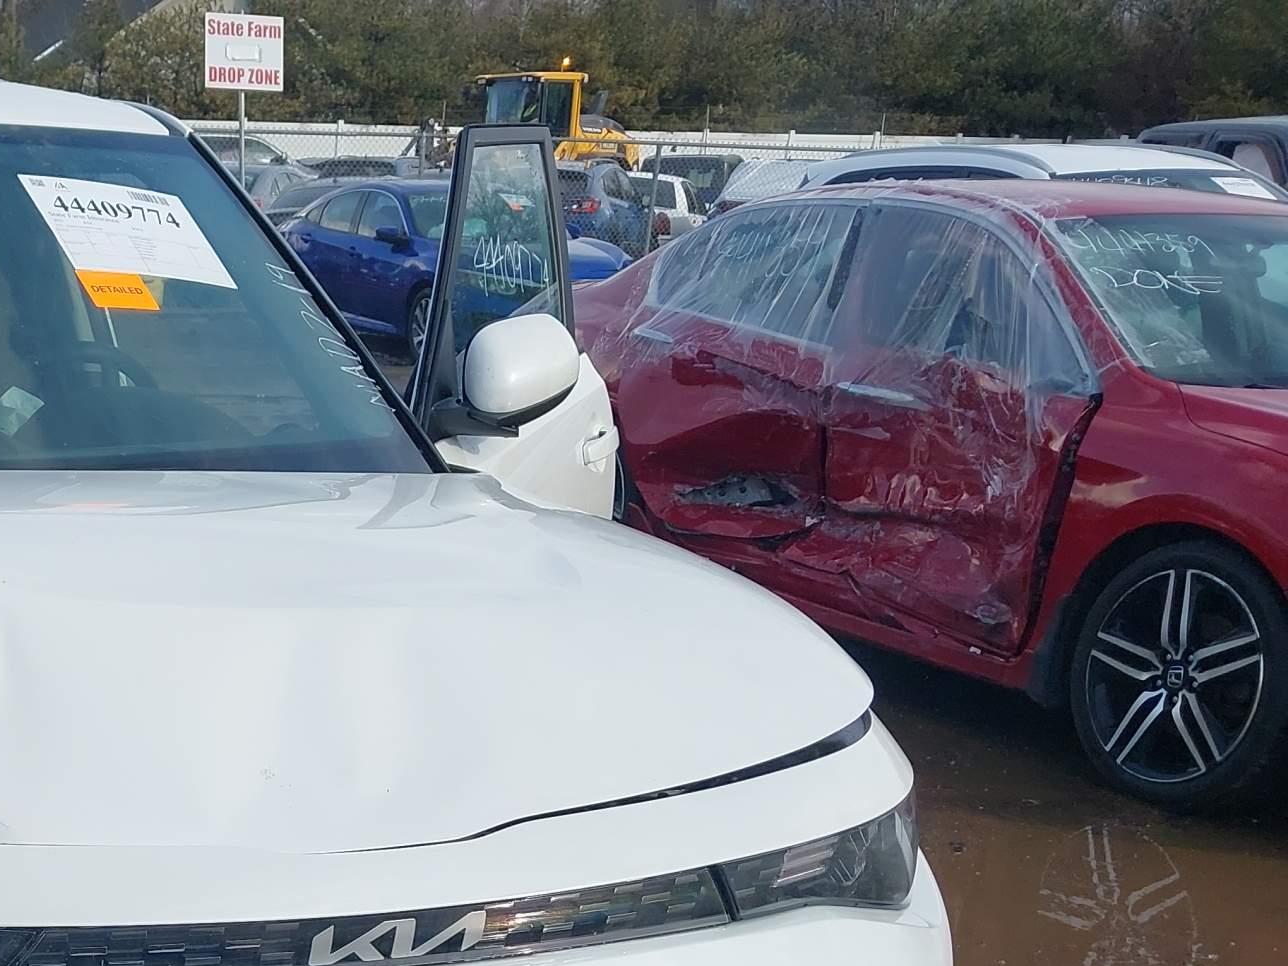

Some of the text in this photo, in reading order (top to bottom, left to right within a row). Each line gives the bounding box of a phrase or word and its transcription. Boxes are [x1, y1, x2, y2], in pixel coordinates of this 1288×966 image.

[208, 19, 281, 39] State Farm
[209, 66, 280, 86] DROP ZONE
[53, 195, 181, 229] 44409774
[90, 284, 144, 296] DETAILED
